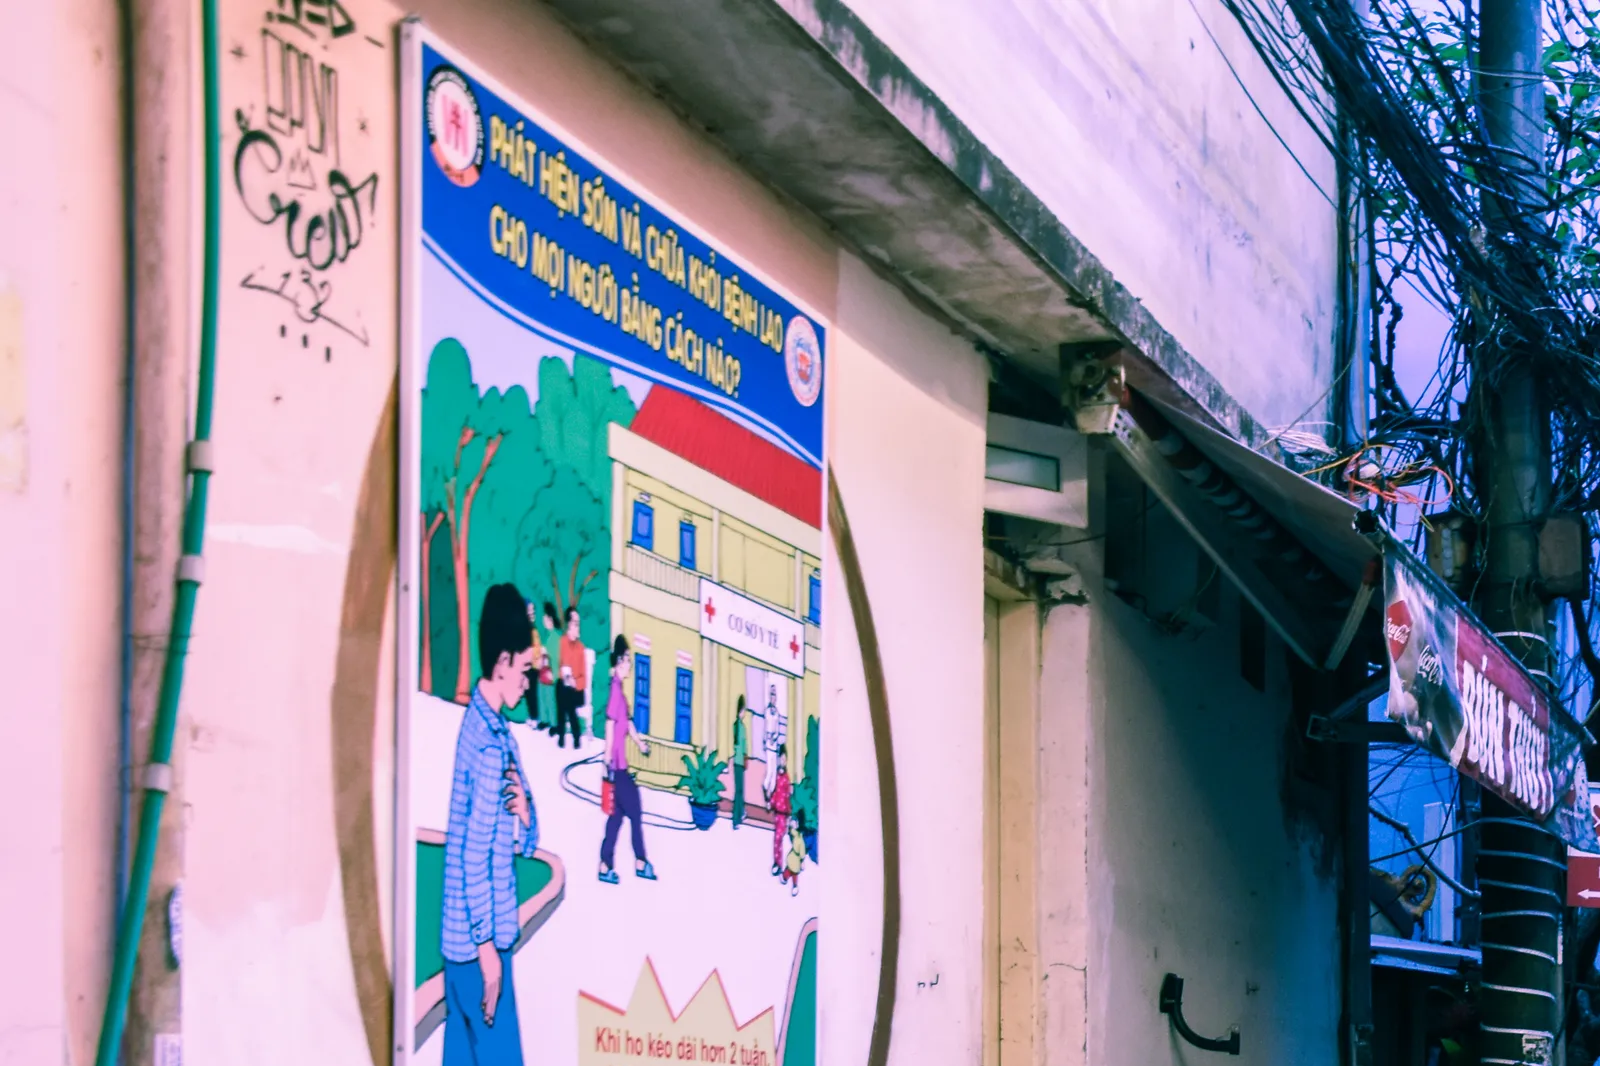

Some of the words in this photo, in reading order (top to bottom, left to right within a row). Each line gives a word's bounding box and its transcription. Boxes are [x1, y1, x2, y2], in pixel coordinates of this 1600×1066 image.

[490, 115, 537, 187] PHÁT
[540, 150, 579, 218] HIỆN
[582, 176, 618, 243] SỚM
[620, 203, 643, 260] VÀ
[645, 225, 686, 289] CHỮA
[689, 251, 721, 312] KHỎI
[723, 275, 758, 337] BỆNH
[760, 305, 783, 353] LAO
[490, 204, 528, 268] CHO
[532, 232, 564, 297] MỌI
[567, 254, 618, 324] NGƯỜI
[621, 272, 662, 351] BẰNG
[665, 312, 703, 376] CÁCH
[706, 338, 741, 398] NÀO?
[595, 1027, 620, 1053] Khi
[626, 1030, 642, 1056] ho
[648, 1033, 672, 1058] kéo
[677, 1036, 697, 1061] dài
[701, 1038, 726, 1063] hơn
[730, 1041, 737, 1065] 2
